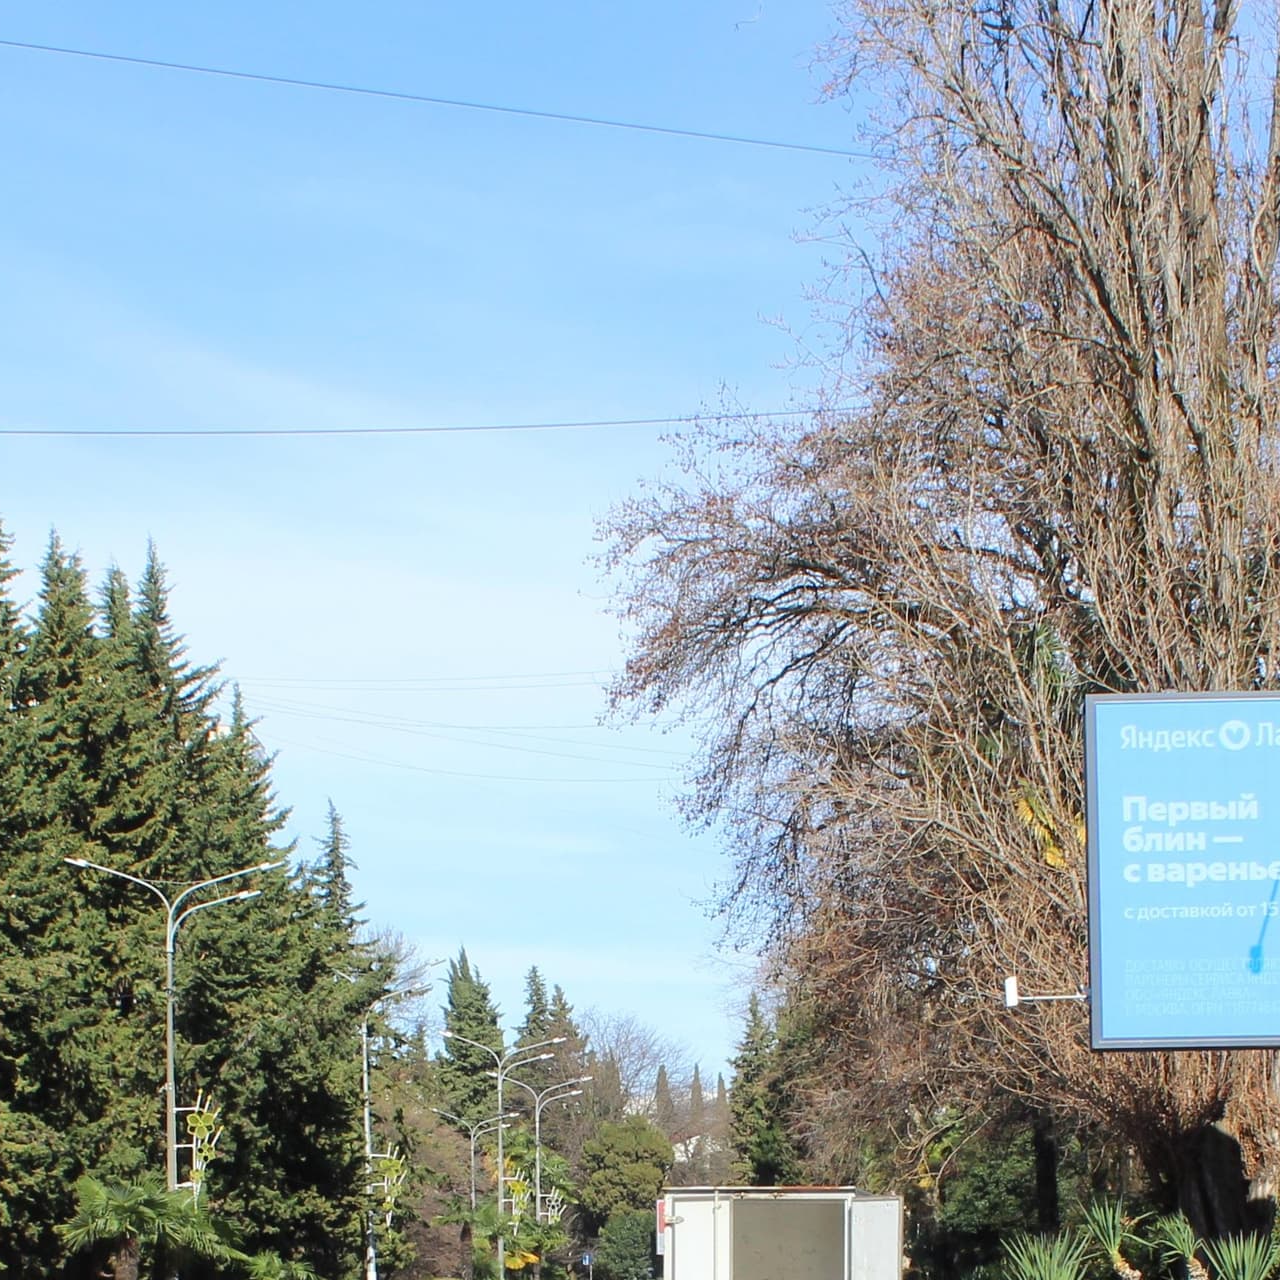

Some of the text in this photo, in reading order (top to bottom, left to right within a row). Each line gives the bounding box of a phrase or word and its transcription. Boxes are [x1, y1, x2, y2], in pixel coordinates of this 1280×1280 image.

[1120, 724, 1216, 750] Яндекс
[1122, 793, 1259, 826] Первый
[1122, 826, 1207, 852] блин
[1123, 863, 1141, 883] с
[1124, 908, 1134, 920] с
[1137, 902, 1232, 921] доставкой
[1236, 905, 1256, 917] от
[1261, 901, 1279, 917] 15
